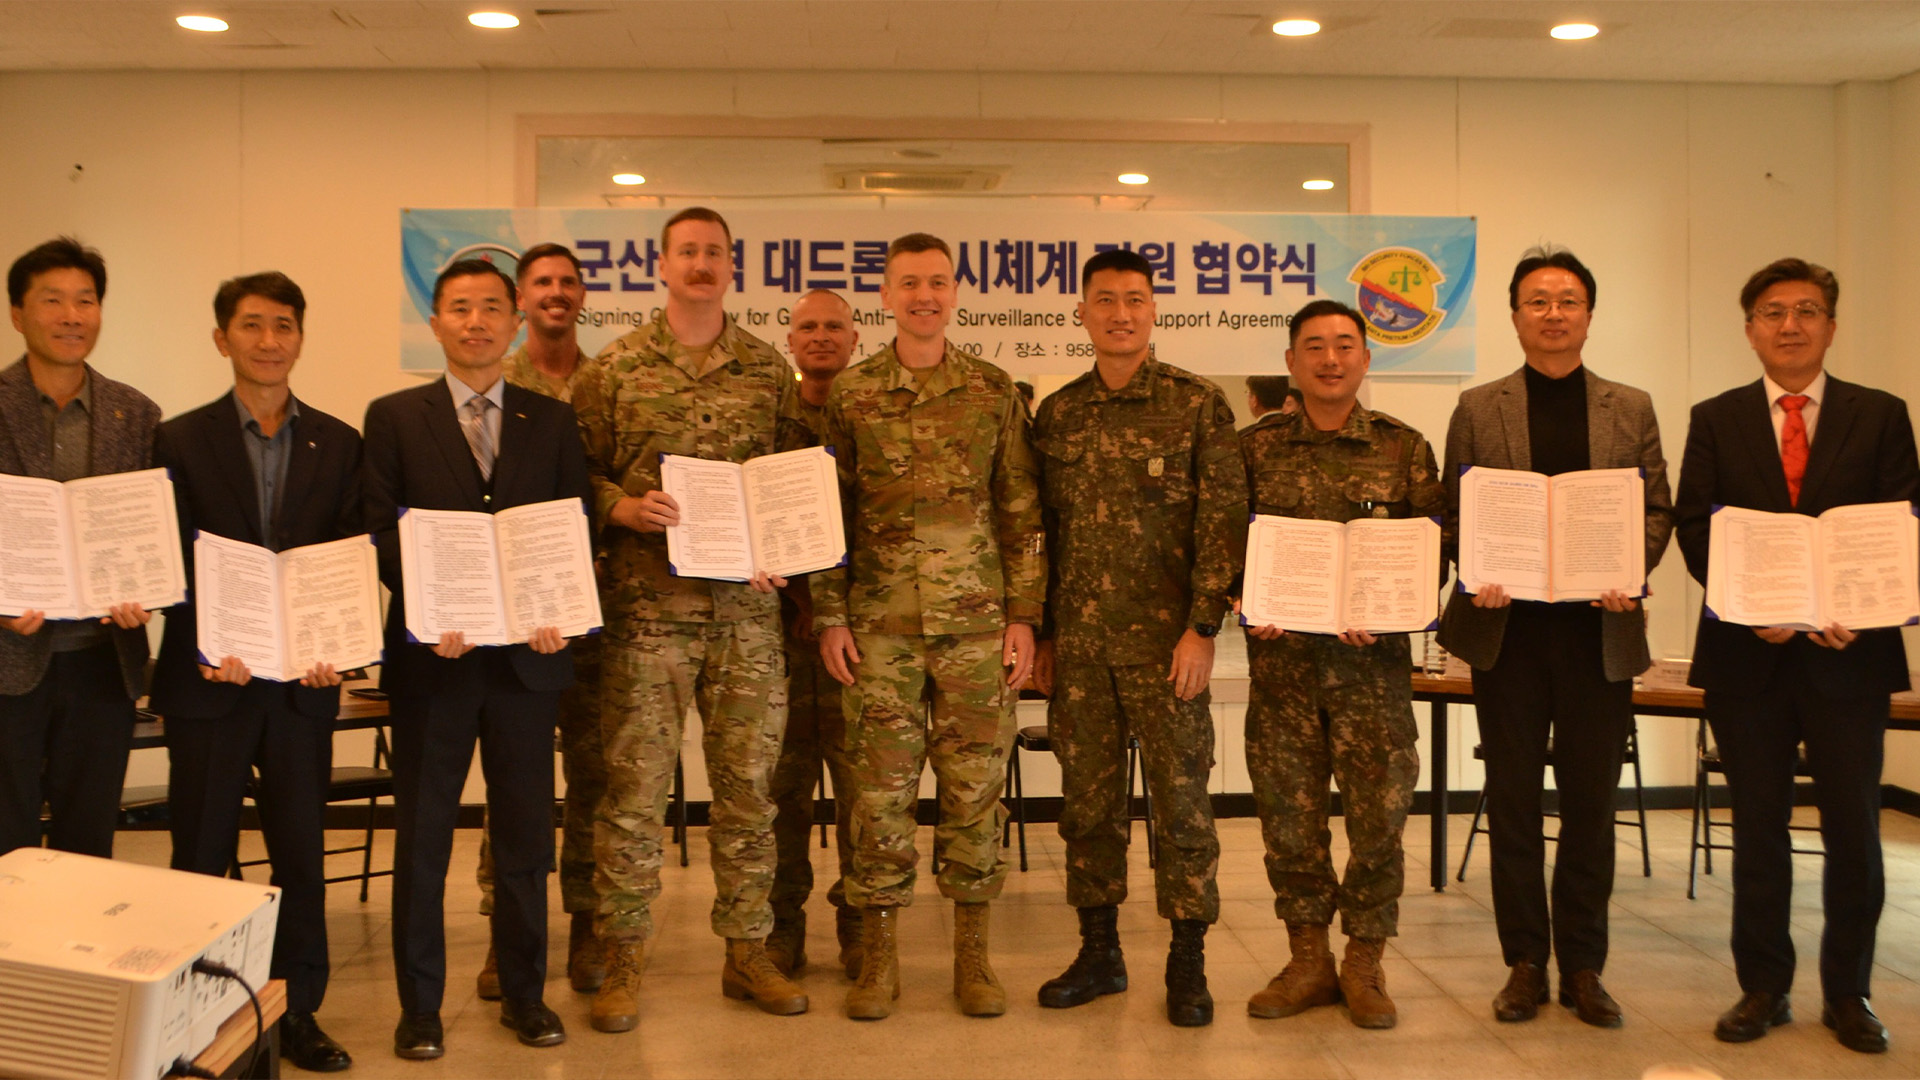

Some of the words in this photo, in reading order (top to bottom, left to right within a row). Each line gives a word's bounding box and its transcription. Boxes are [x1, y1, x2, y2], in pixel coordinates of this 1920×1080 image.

[764, 239, 889, 293] 대드론
[955, 239, 1077, 294] 시체계
[1193, 241, 1316, 296] 협약식
[577, 307, 643, 327] Signing
[747, 308, 769, 326] for
[957, 308, 1065, 327] Surveillance
[1153, 311, 1211, 330] upport
[1217, 310, 1295, 330] Agreeme
[1014, 342, 1046, 359] 장소
